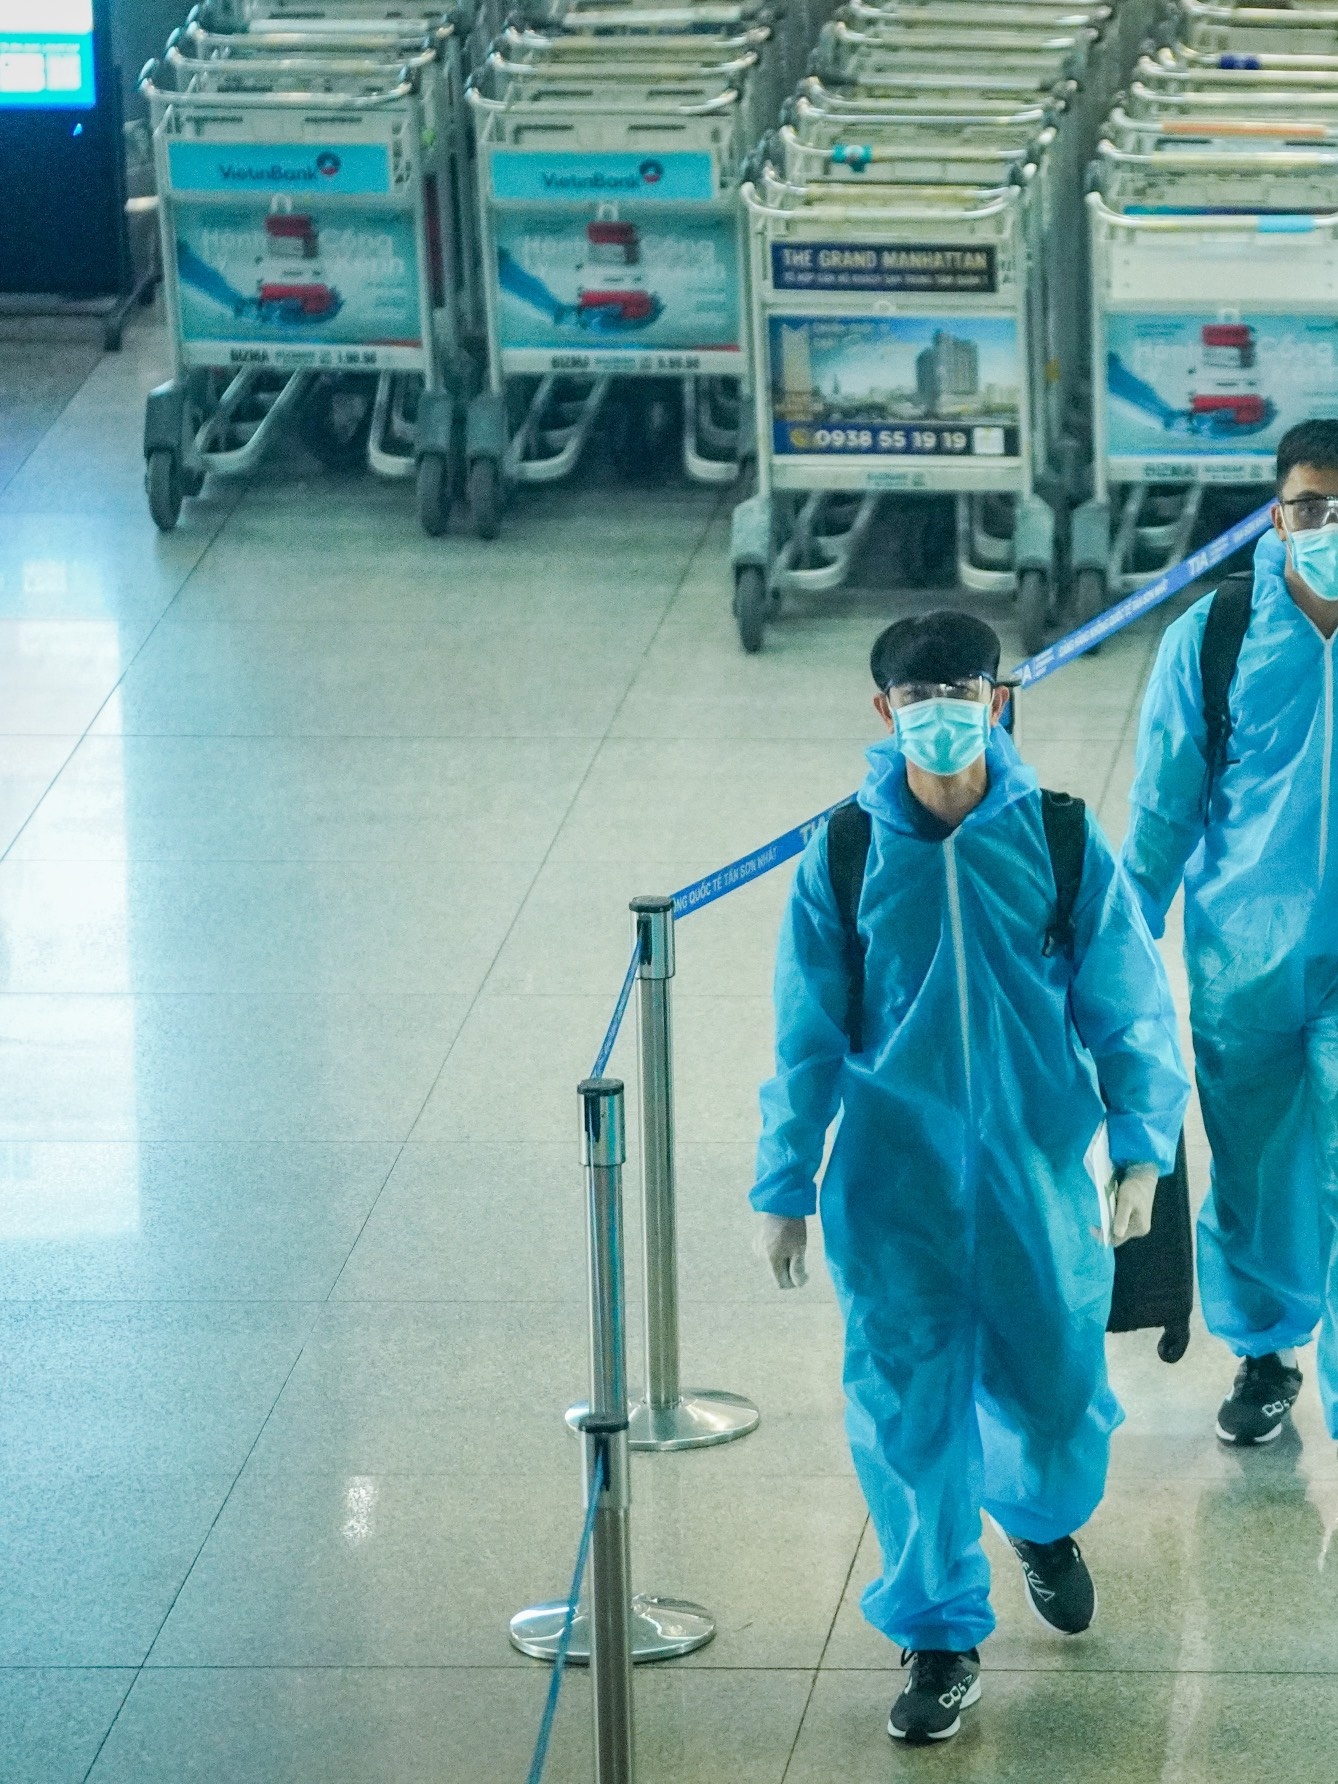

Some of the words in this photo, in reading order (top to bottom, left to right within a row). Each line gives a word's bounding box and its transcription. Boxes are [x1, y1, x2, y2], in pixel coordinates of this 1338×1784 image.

[220, 164, 318, 181] VietinBank
[542, 171, 641, 189] VietinBank
[783, 249, 814, 267] THE
[818, 249, 878, 268] GRAND
[882, 250, 988, 269] MANHATTAN
[814, 429, 873, 447] 0938
[878, 430, 907, 448] 55
[912, 431, 937, 449] 19
[942, 432, 968, 449] 19
